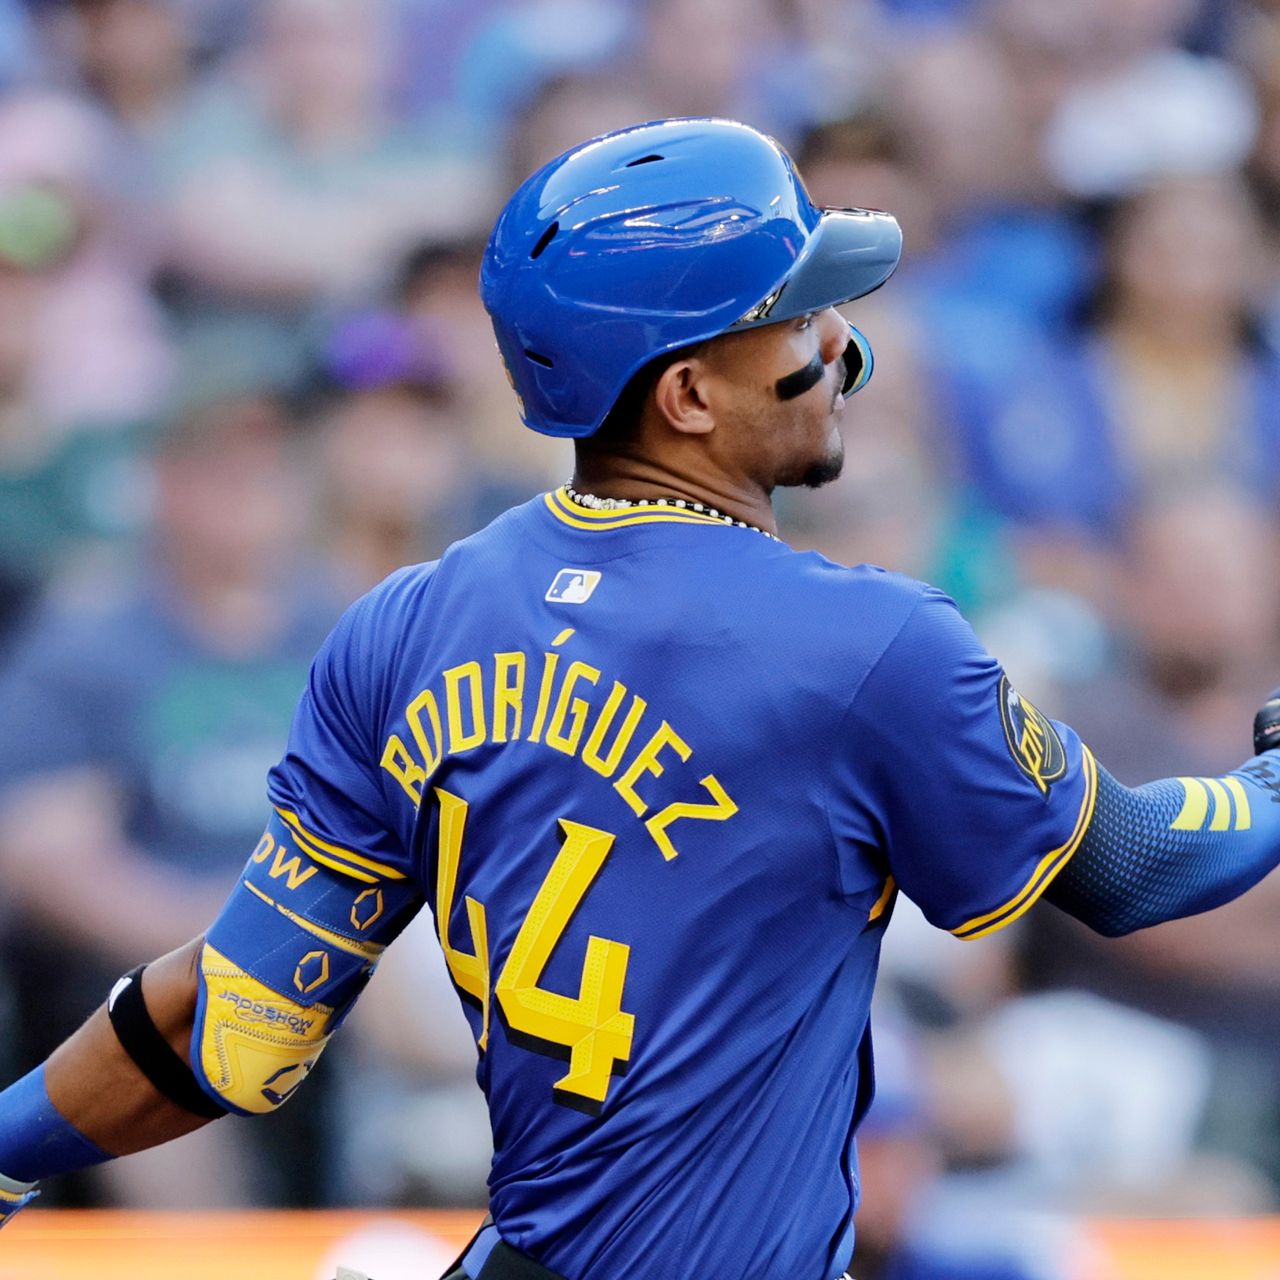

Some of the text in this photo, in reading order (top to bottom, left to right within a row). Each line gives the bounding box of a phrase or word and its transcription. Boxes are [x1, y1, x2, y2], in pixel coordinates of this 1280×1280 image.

[380, 628, 740, 863] RODRÍGUEZ
[218, 989, 315, 1028] JRODSHOW
[431, 786, 635, 1106] 44
